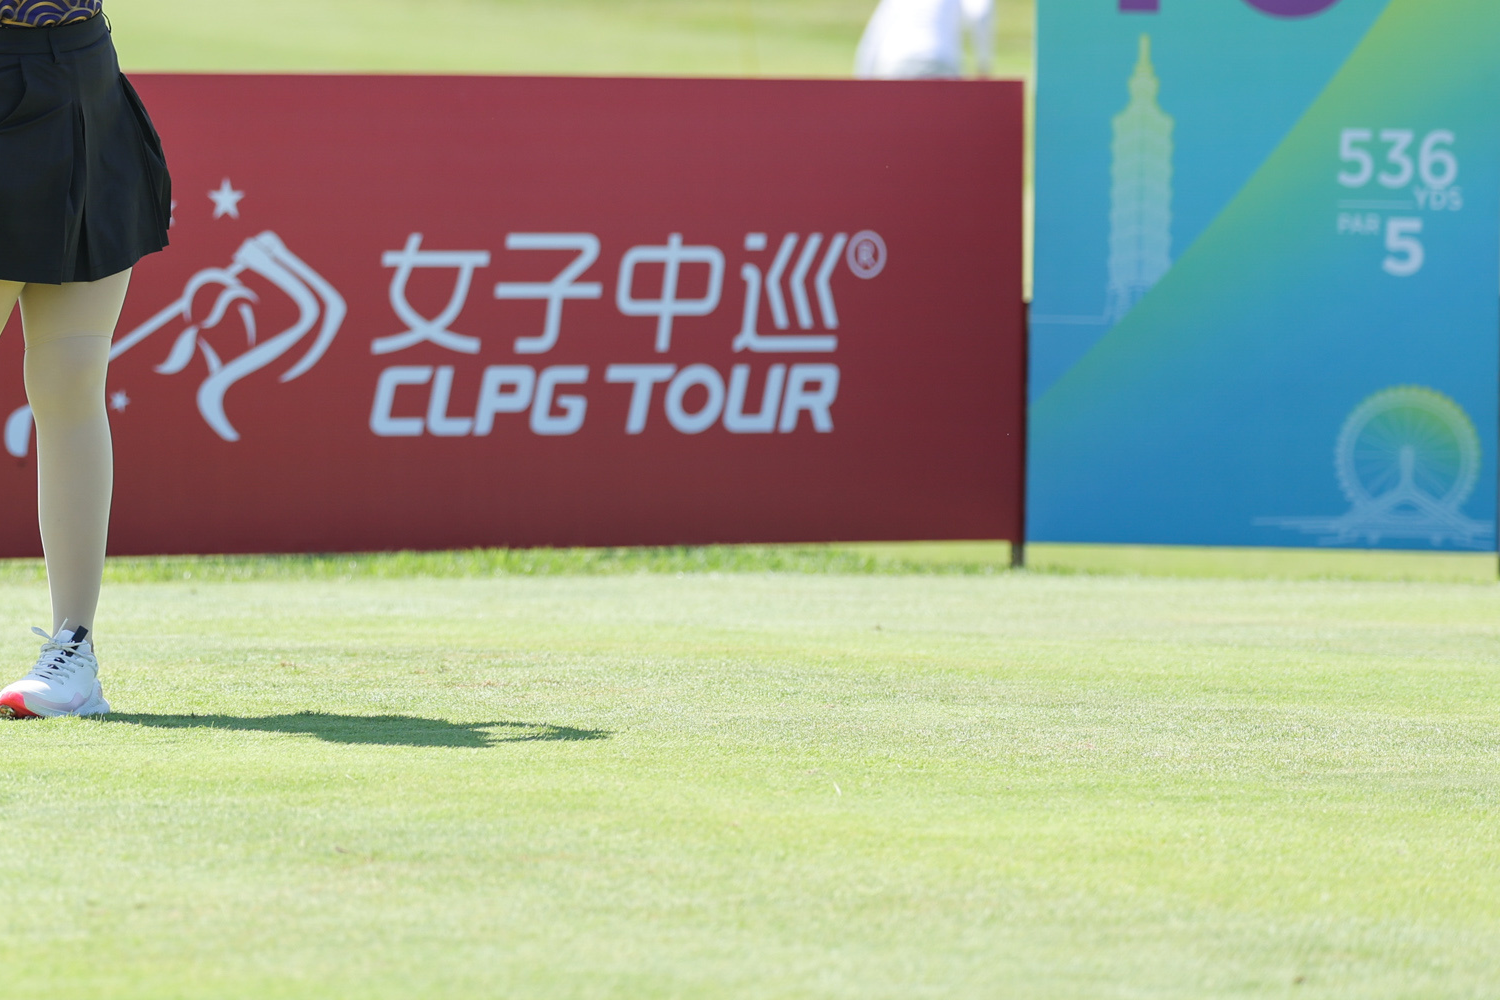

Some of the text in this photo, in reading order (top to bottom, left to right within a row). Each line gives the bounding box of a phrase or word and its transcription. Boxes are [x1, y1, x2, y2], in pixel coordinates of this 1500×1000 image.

[1336, 127, 1459, 190] 536
[1412, 185, 1464, 212] YDS
[1336, 212, 1426, 277] PAR 5
[369, 231, 850, 355] 女子中巡
[368, 363, 841, 437] CLPG TOUR
